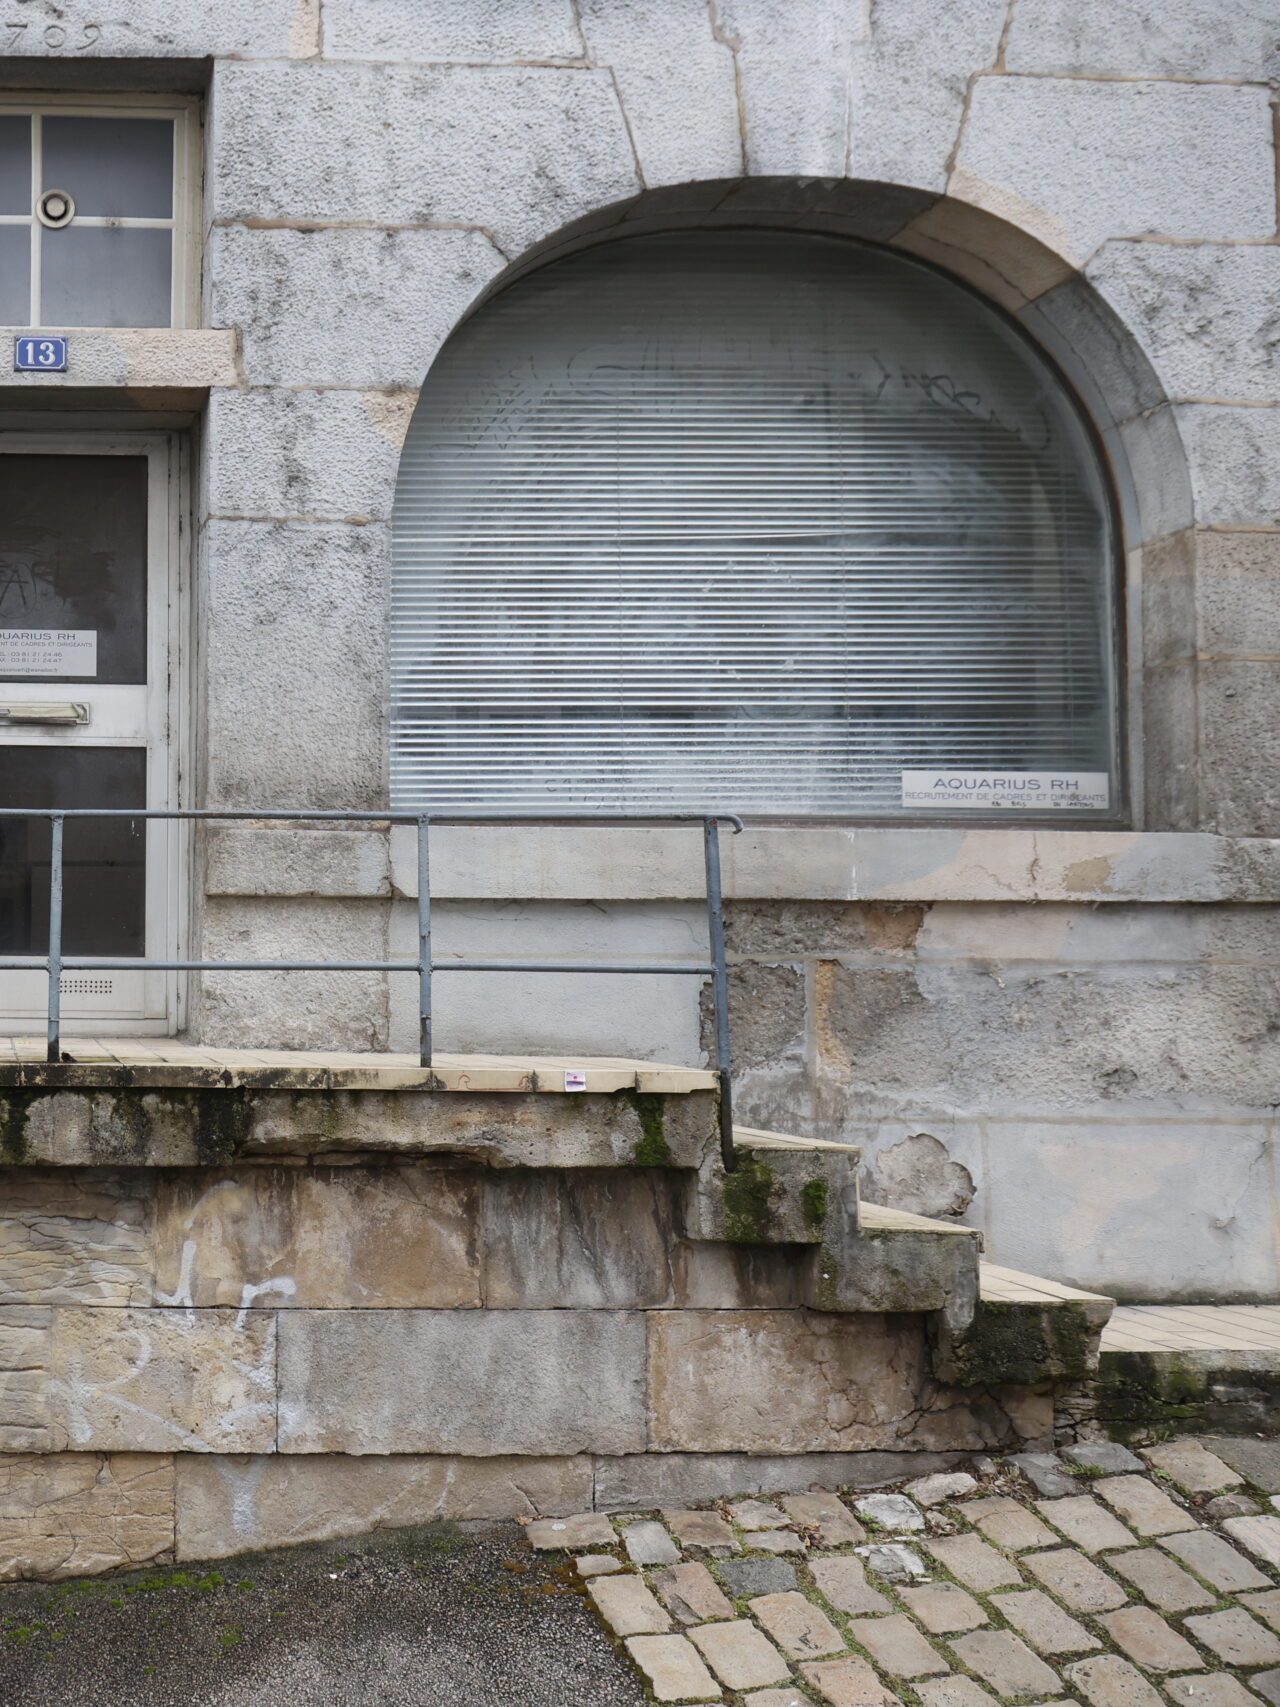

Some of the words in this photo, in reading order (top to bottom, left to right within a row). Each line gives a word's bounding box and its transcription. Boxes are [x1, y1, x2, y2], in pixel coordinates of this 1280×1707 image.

[26, 341, 56, 365] 13
[57, 633, 76, 641] RH
[933, 778, 1041, 790] AQUARIUS
[1051, 779, 1079, 790] RH
[905, 791, 973, 800] RECRUTEMENT
[977, 792, 990, 801] DE
[993, 793, 1033, 801] CADRES
[1036, 793, 1047, 801] ET
